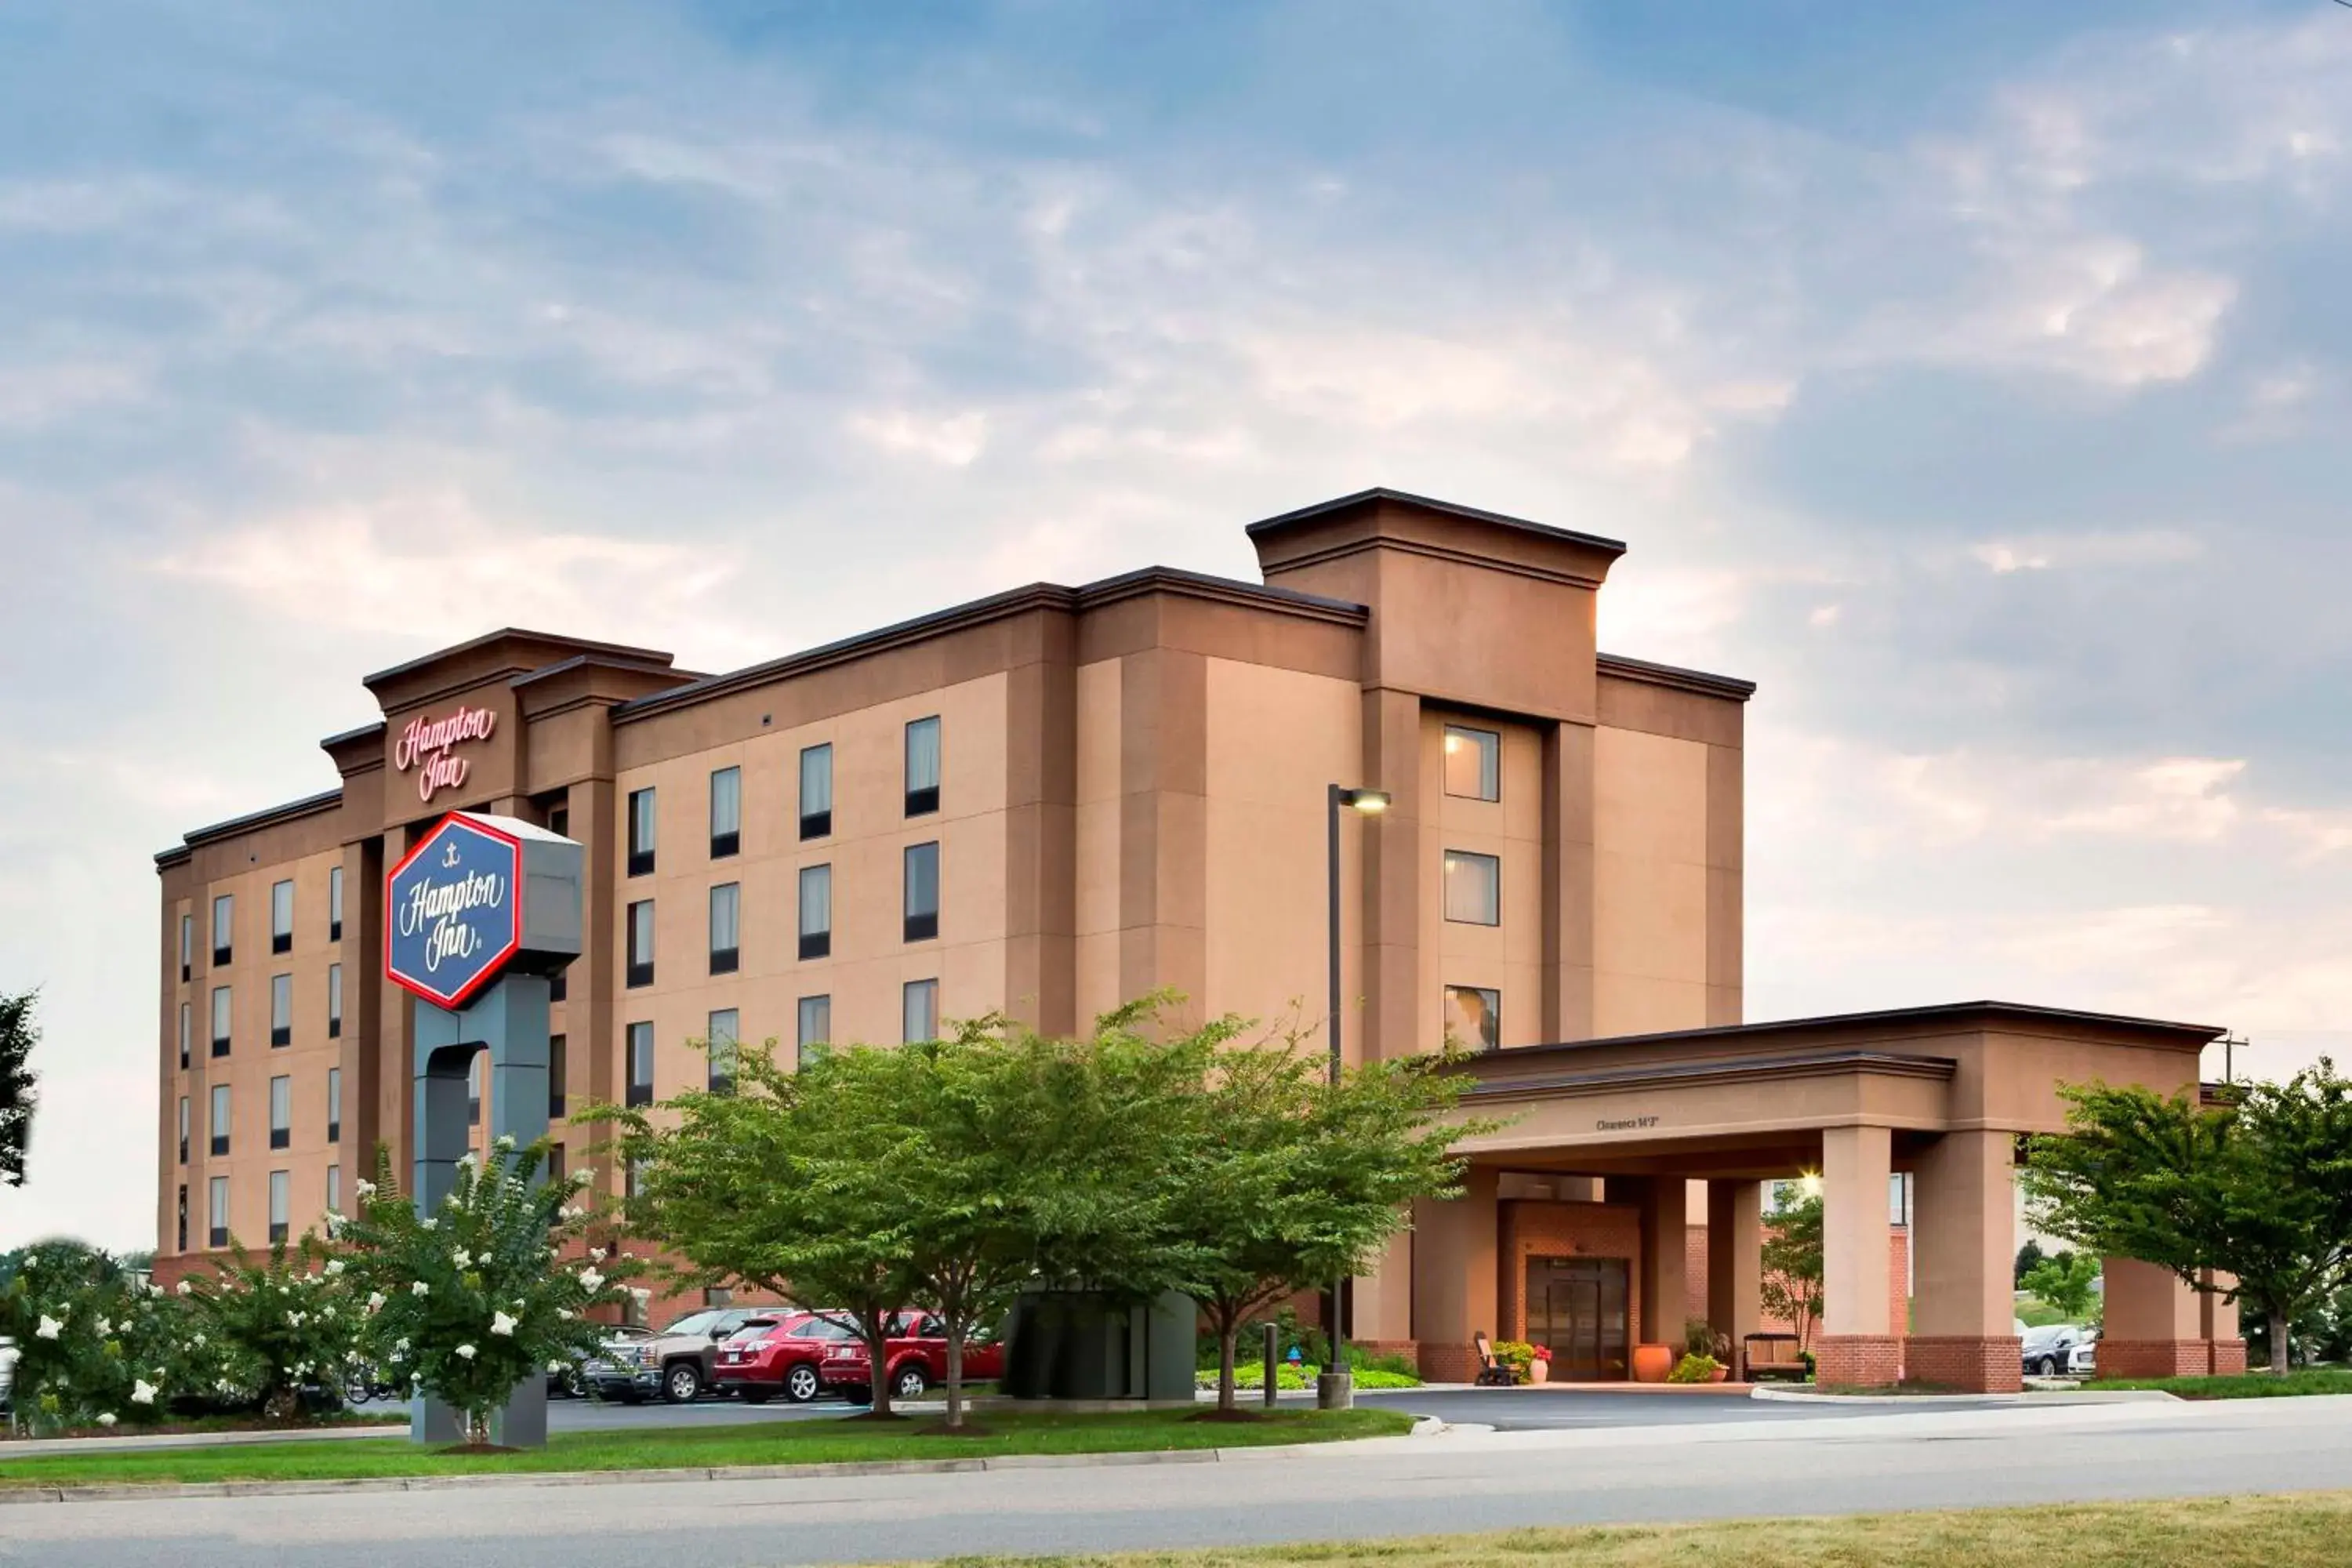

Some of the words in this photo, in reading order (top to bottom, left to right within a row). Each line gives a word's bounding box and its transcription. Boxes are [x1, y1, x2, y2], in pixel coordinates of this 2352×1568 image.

[396, 706, 497, 771] Hampton
[419, 750, 470, 802] Inn
[399, 869, 504, 937] Hampton
[426, 915, 475, 972] Inn
